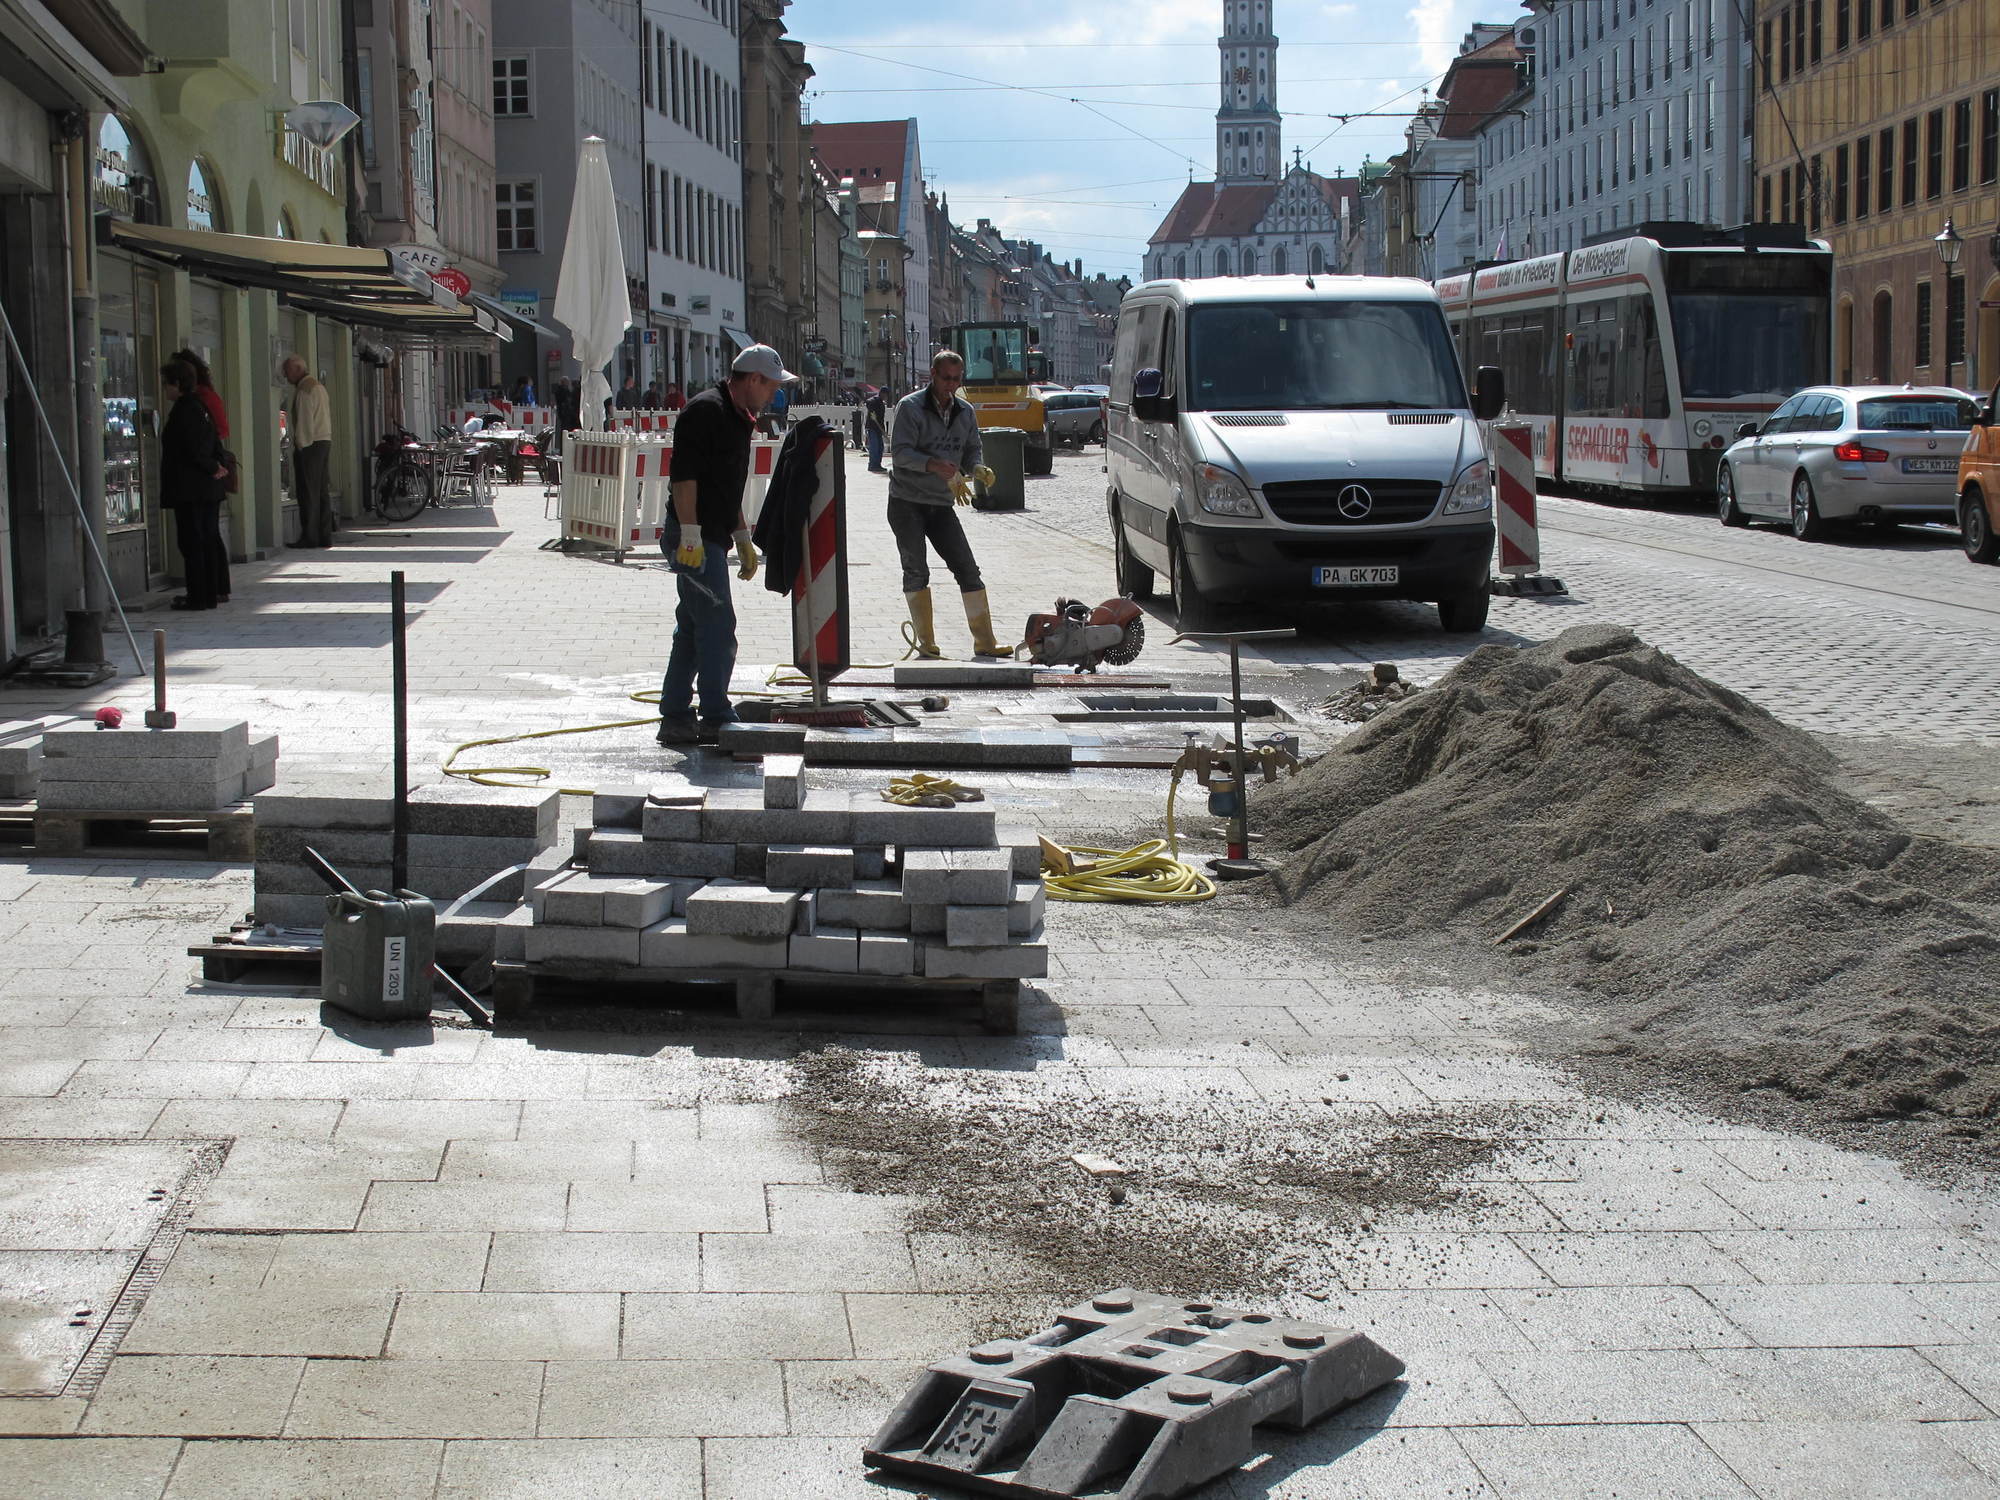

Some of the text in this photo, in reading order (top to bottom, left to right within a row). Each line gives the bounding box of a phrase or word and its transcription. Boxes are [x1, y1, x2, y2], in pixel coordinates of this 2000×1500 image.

[400, 251, 439, 268] CAFE
[1572, 243, 1627, 275] Der Möbelgigant
[1522, 260, 1556, 283] Friedberg
[515, 306, 535, 315] Zeh
[1567, 423, 1629, 464] SEGMÜLLER
[1322, 568, 1397, 582] PA GK 703
[388, 942, 400, 997] UN 1203
